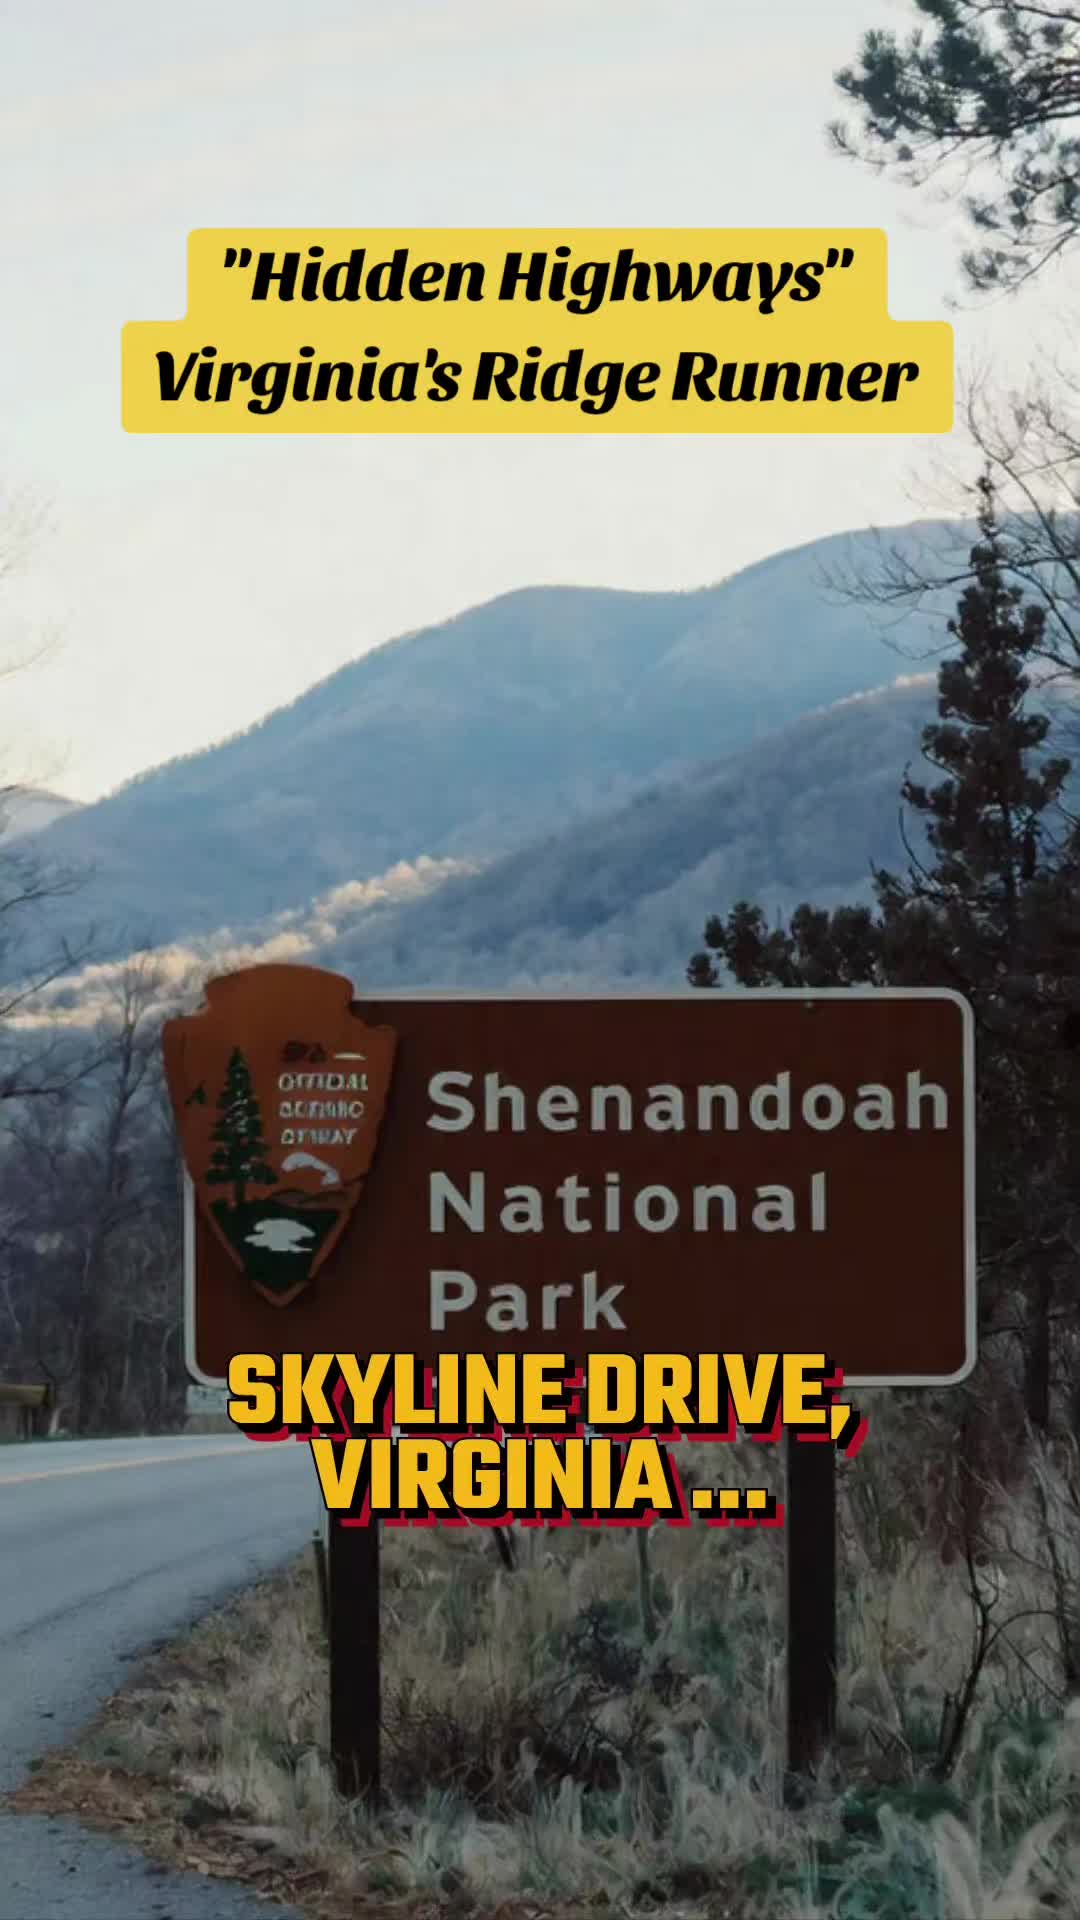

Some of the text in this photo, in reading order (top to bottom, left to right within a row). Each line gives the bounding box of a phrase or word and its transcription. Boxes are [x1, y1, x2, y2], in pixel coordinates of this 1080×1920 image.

[426, 1070, 948, 1132] Shenandoah
[429, 1171, 826, 1233] National
[429, 1270, 627, 1332] Park
